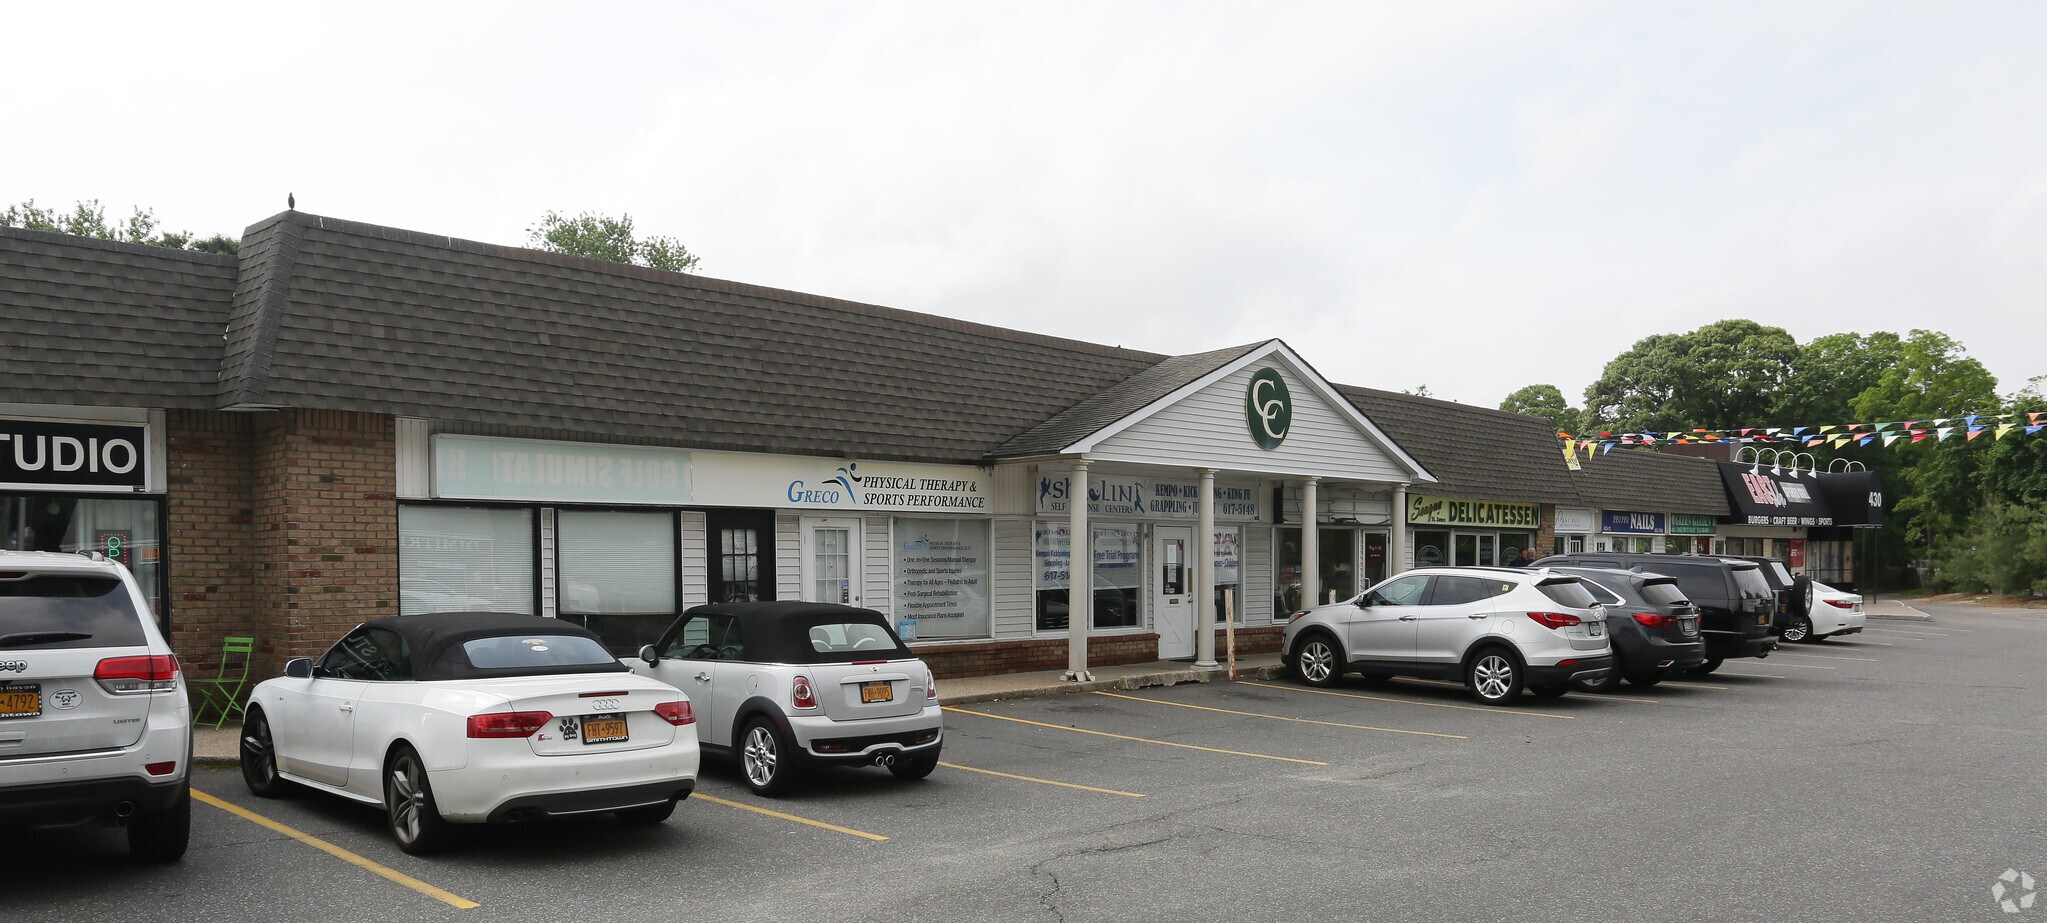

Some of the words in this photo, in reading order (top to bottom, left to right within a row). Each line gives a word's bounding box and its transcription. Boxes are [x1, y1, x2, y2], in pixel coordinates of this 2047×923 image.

[863, 475, 917, 490] PHYSICAL
[919, 478, 968, 492] THERAPY
[969, 482, 977, 492] &
[863, 492, 905, 506] SPORTS
[907, 494, 985, 508] PERFORMANCE
[1155, 484, 1178, 497] KEMPO
[1243, 488, 1251, 501] FU
[1868, 491, 1882, 507] 430
[1051, 502, 1066, 511] SELF
[1104, 504, 1133, 513] CENTERS
[1150, 500, 1187, 513] GRAPPLING
[1222, 503, 1255, 515] 617-5148
[1448, 500, 1540, 526] DELICATESSEN
[1630, 513, 1655, 530] NAILS
[1747, 515, 1769, 524] BURGERS
[1773, 516, 1786, 525] CRAFT
[1787, 516, 1797, 525] BEER
[1800, 517, 1815, 525] WINGS
[1818, 517, 1833, 525] SPORTS
[962, 556, 976, 564] Therapy
[1094, 550, 1105, 560] Free
[1105, 550, 1117, 560] Trial
[1117, 550, 1139, 562] Program
[1044, 571, 1070, 580] 617-51
[907, 590, 932, 598] Post-Surgical
[923, 601, 946, 609] Appointment
[7, 694, 34, 709] 4792
